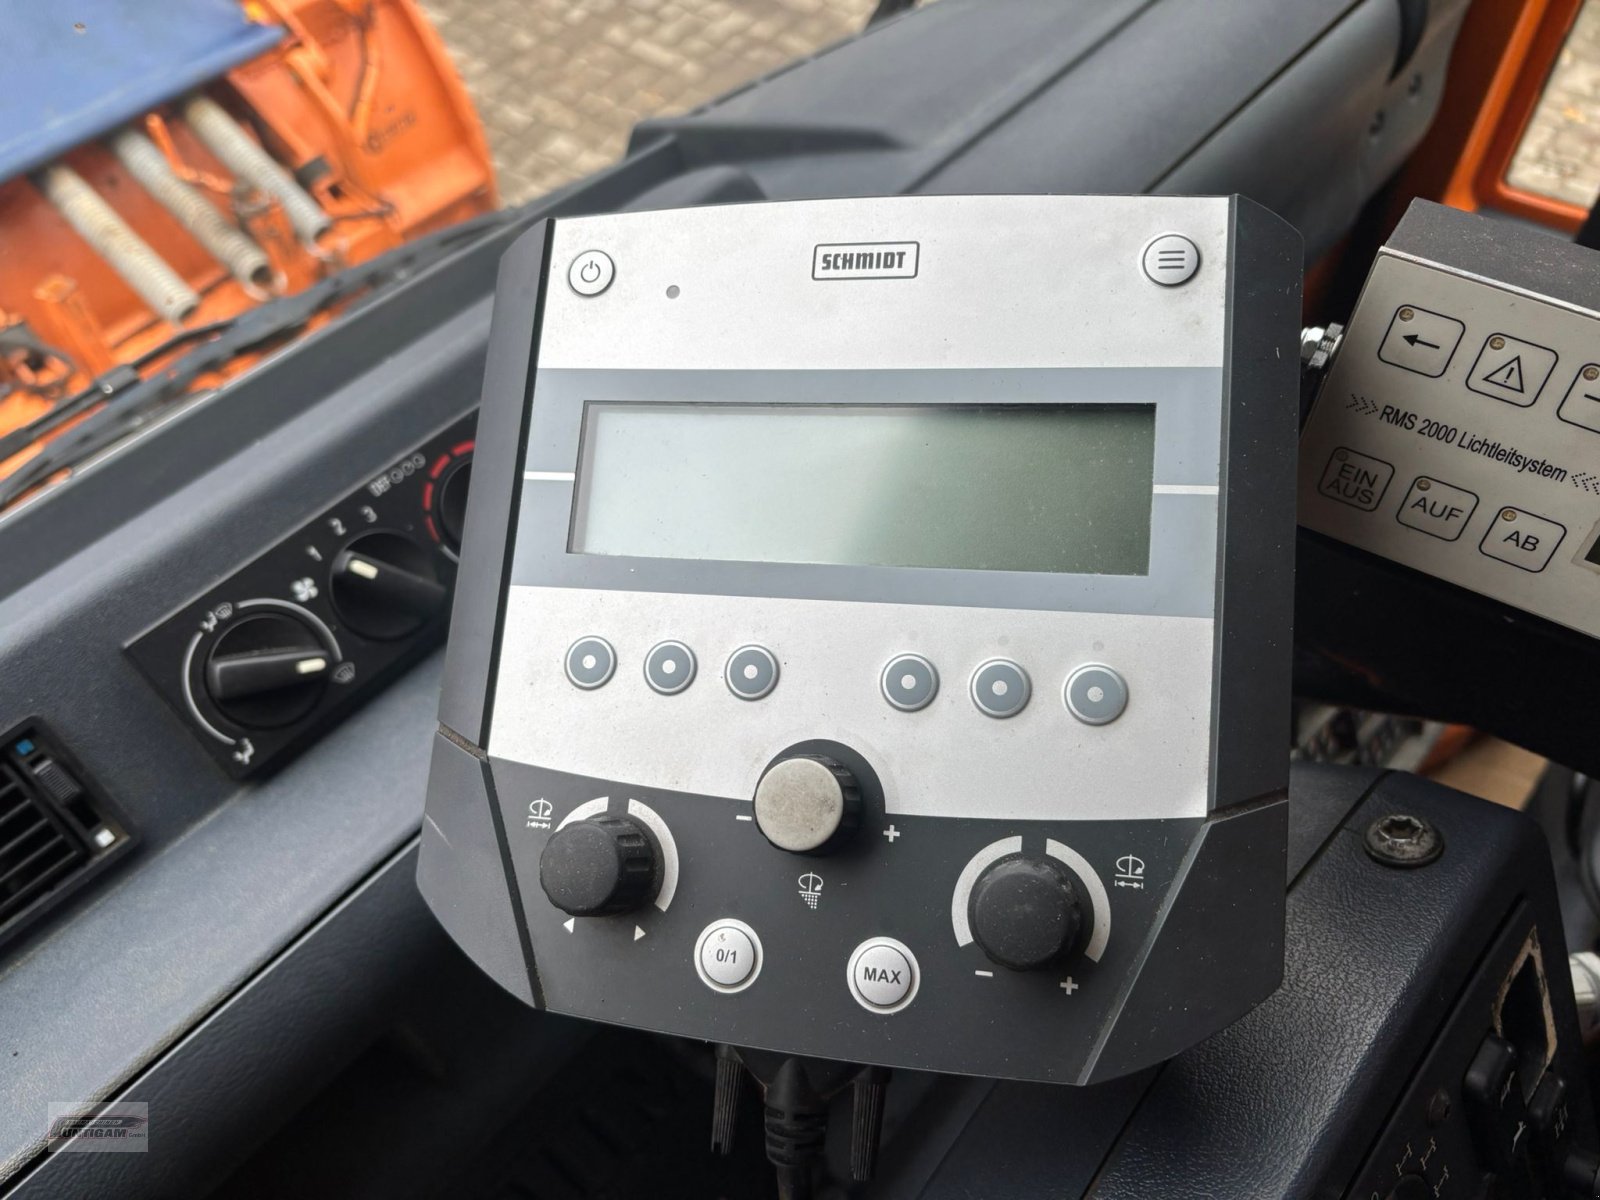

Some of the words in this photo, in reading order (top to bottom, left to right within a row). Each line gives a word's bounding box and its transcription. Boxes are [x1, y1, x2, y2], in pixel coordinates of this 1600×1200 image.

[821, 252, 906, 270] SCHMIDT
[1379, 405, 1418, 431] RMS
[1418, 418, 1457, 444] 2000
[1457, 431, 1568, 482] Lichtleitsystem
[1339, 463, 1379, 488] EIN
[1326, 479, 1374, 505] AUS
[1411, 496, 1464, 522] AUF
[329, 518, 347, 536] 2
[1503, 530, 1540, 552] AB
[716, 948, 737, 964] 0/1
[863, 967, 901, 985] MAX
